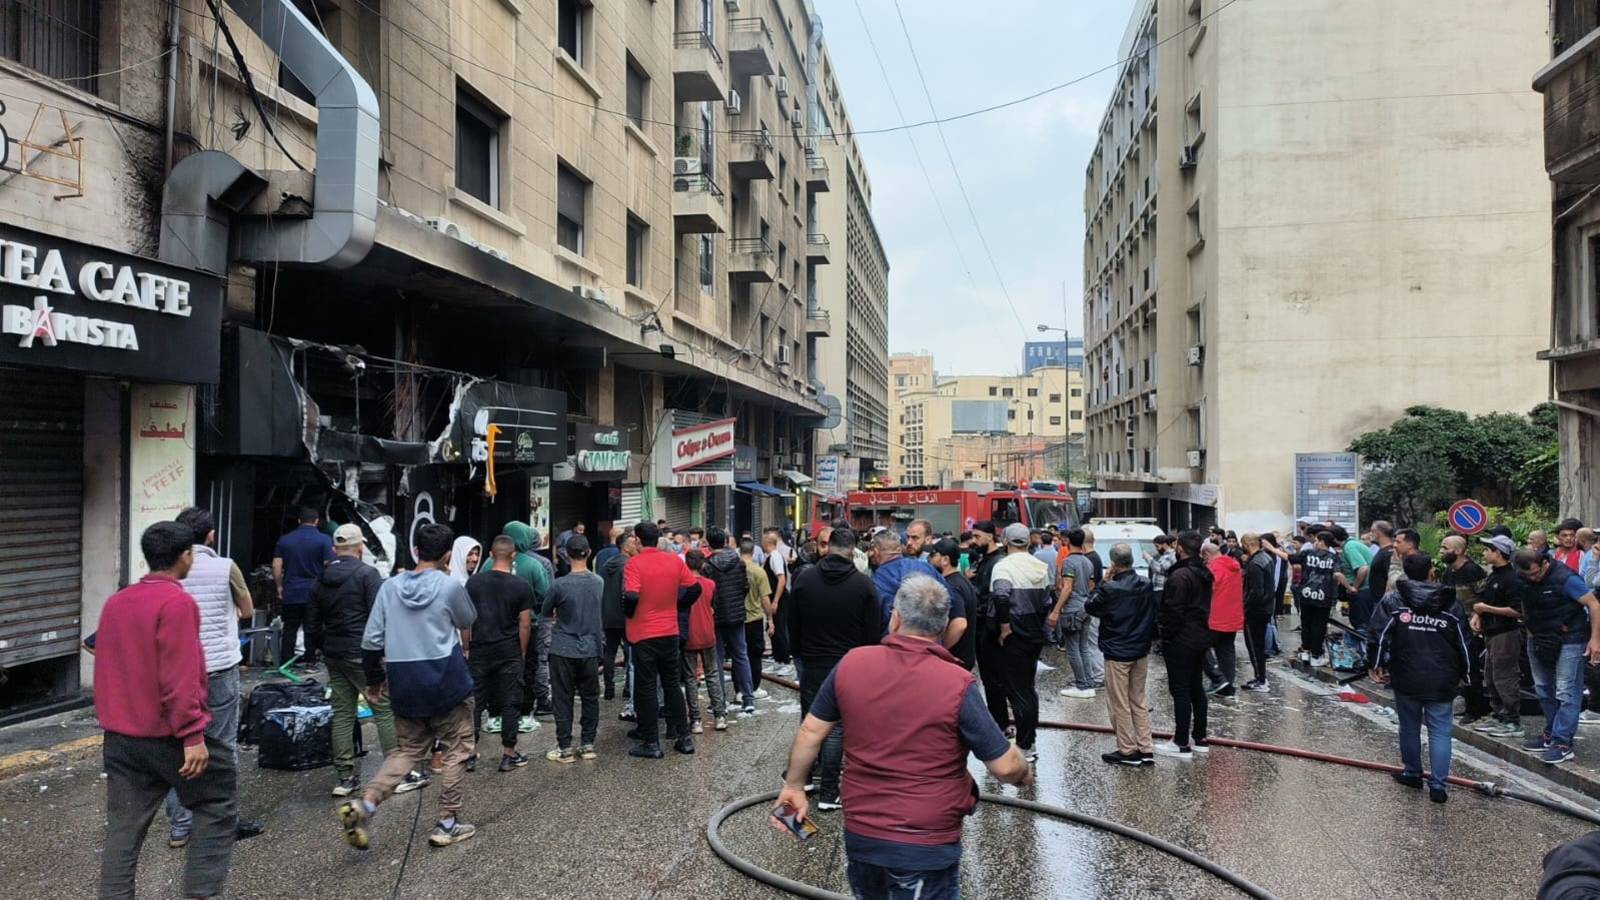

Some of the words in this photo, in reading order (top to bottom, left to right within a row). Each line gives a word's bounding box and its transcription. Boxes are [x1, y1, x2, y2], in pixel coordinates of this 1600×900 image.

[79, 261, 192, 317] CAFE
[3, 295, 139, 350] BARISTA
[144, 465, 184, 498] LTEIF
[1306, 555, 1334, 569] Wait
[1302, 586, 1325, 600] God
[1412, 613, 1447, 628] toters
